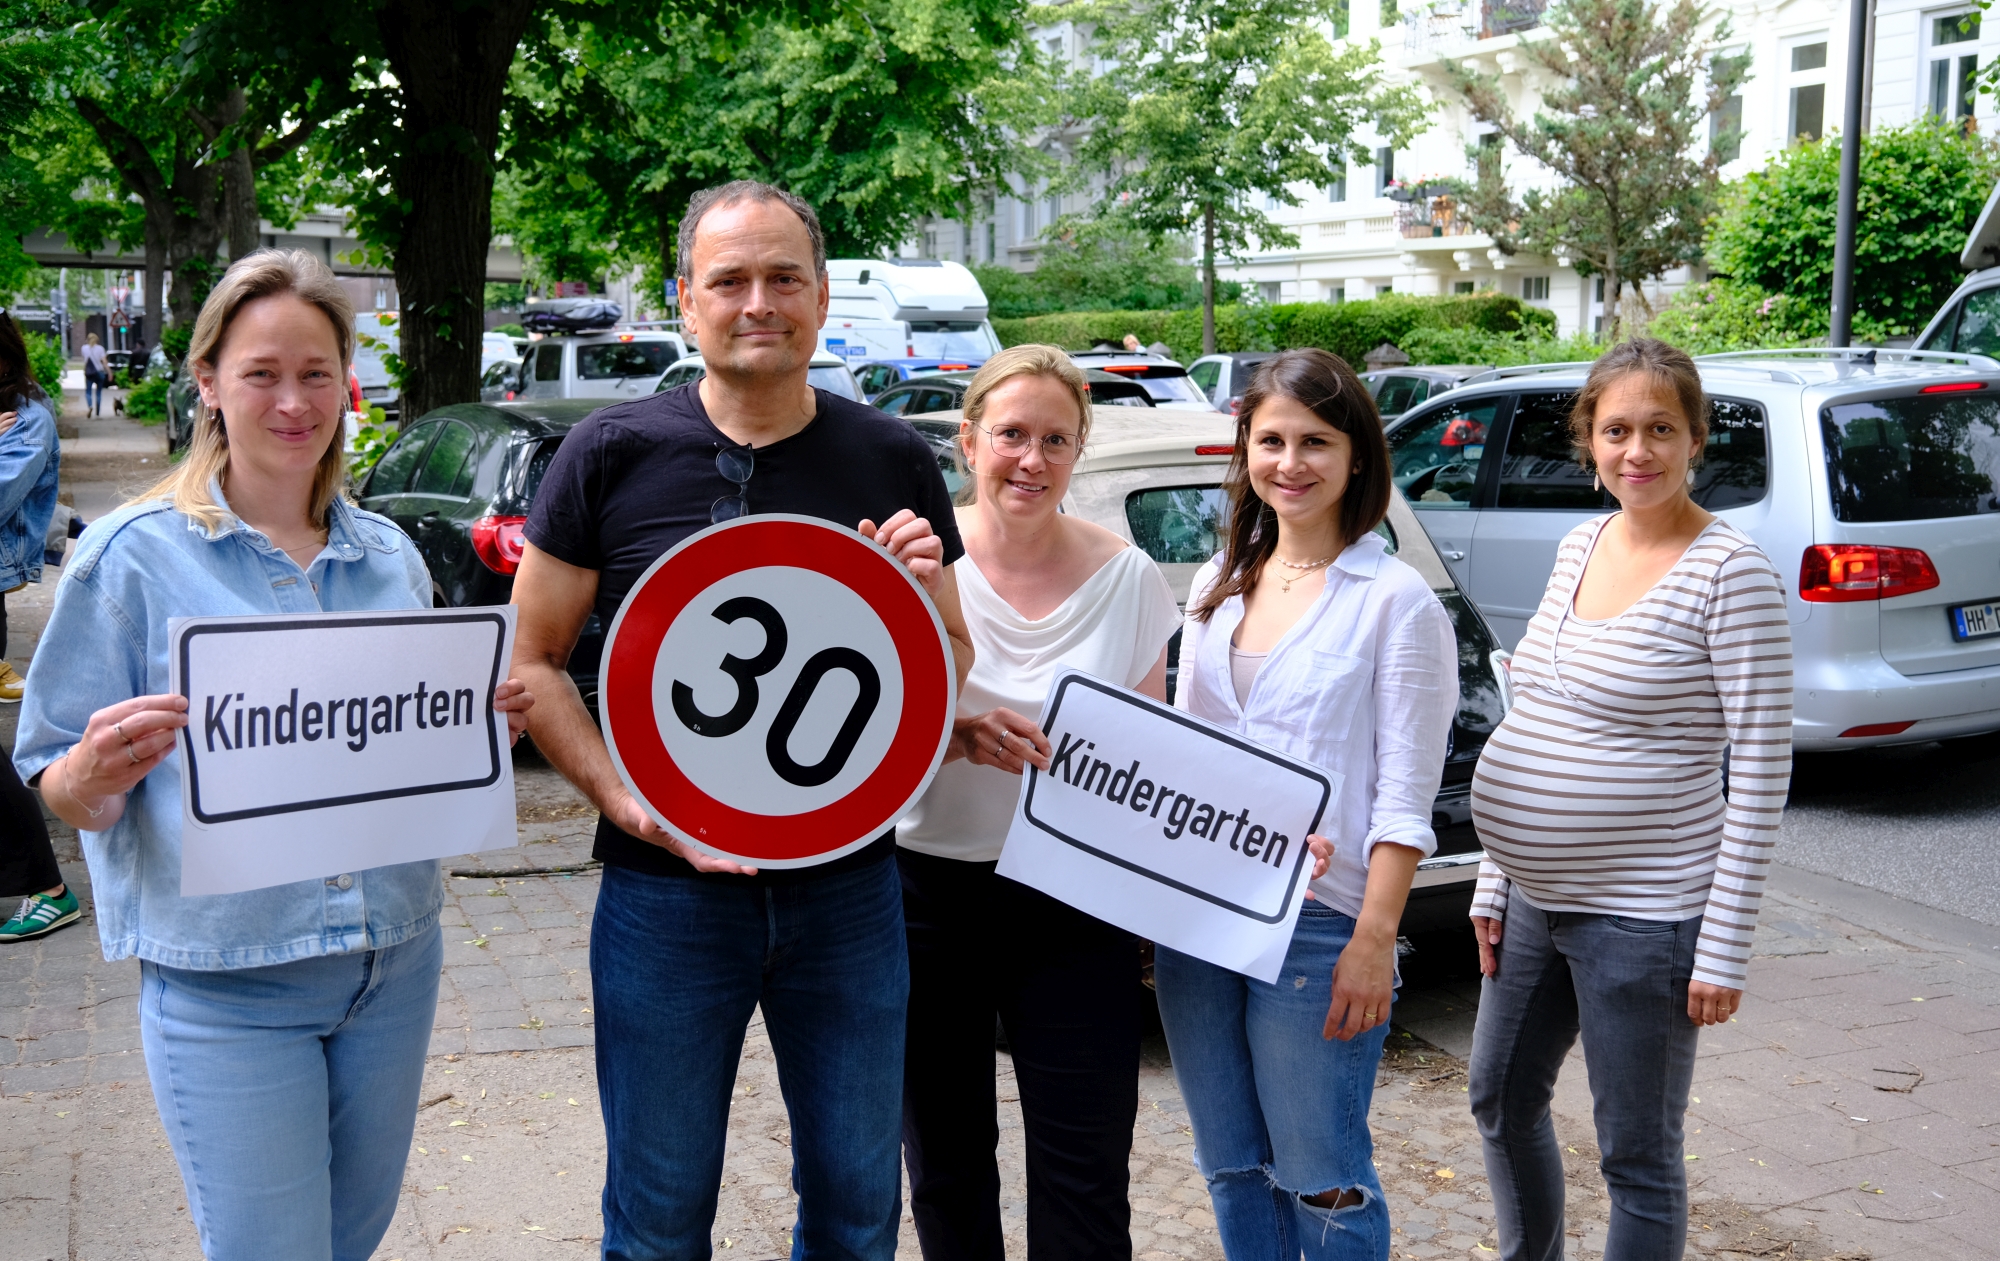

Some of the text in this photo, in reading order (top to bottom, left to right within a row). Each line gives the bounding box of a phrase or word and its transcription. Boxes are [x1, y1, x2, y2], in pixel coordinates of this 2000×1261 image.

[205, 682, 473, 753] Kindergarten
[672, 597, 880, 787] 30
[1049, 733, 1290, 868] Kindergarten
